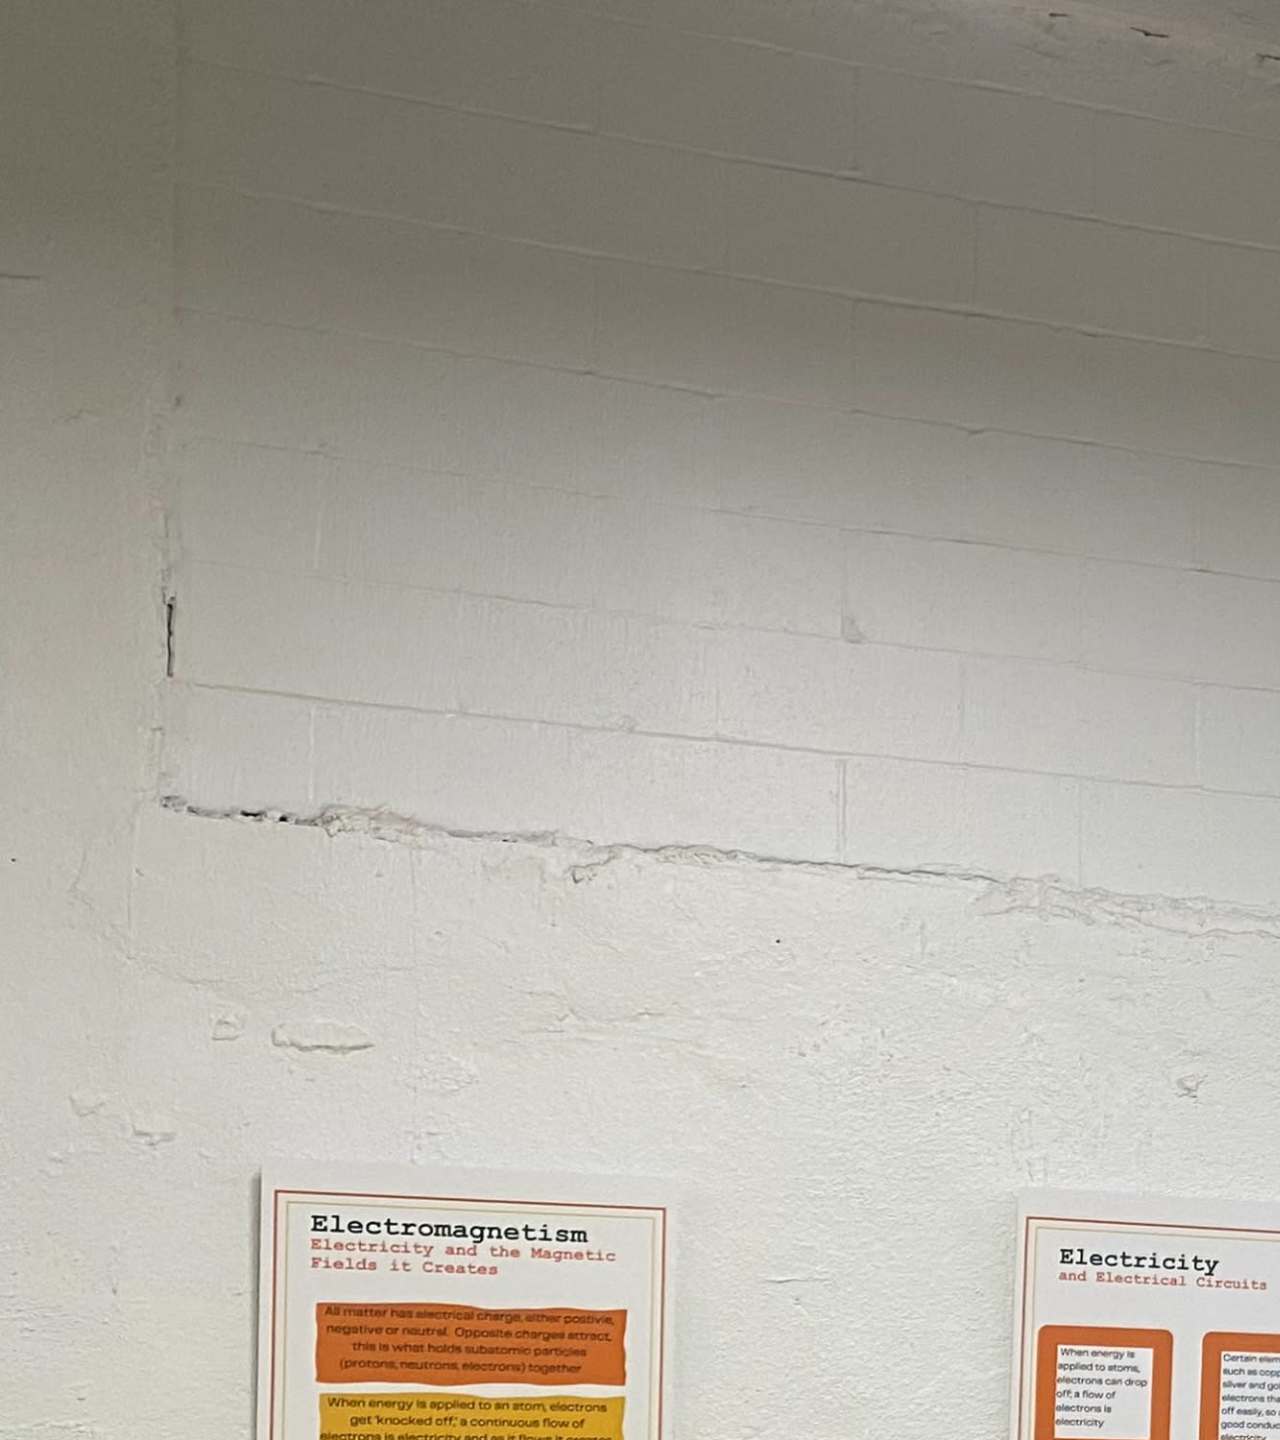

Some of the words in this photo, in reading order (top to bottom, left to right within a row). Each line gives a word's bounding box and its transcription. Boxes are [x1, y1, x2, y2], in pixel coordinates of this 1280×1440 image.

[310, 1215, 588, 1243] Electromagnetism
[310, 1239, 434, 1257] Electricity
[445, 1243, 478, 1257] and
[490, 1243, 521, 1259] the
[531, 1248, 616, 1263] Magnetic
[310, 1257, 377, 1271] Fields
[389, 1259, 411, 1272] it
[422, 1261, 499, 1275] Creates
[1059, 1249, 1219, 1276] Electricity
[1059, 1270, 1087, 1282] and
[1096, 1272, 1186, 1286] Electrical
[1197, 1277, 1267, 1291] Circuits
[328, 1398, 365, 1408] When
[369, 1400, 413, 1411] energy
[416, 1401, 427, 1409] is
[430, 1401, 475, 1412] applied
[479, 1402, 492, 1410] to
[550, 1402, 607, 1412] electrons
[350, 1416, 371, 1427] get
[470, 1418, 540, 1428] continuous
[543, 1418, 569, 1428] flow
[572, 1419, 585, 1428] of
